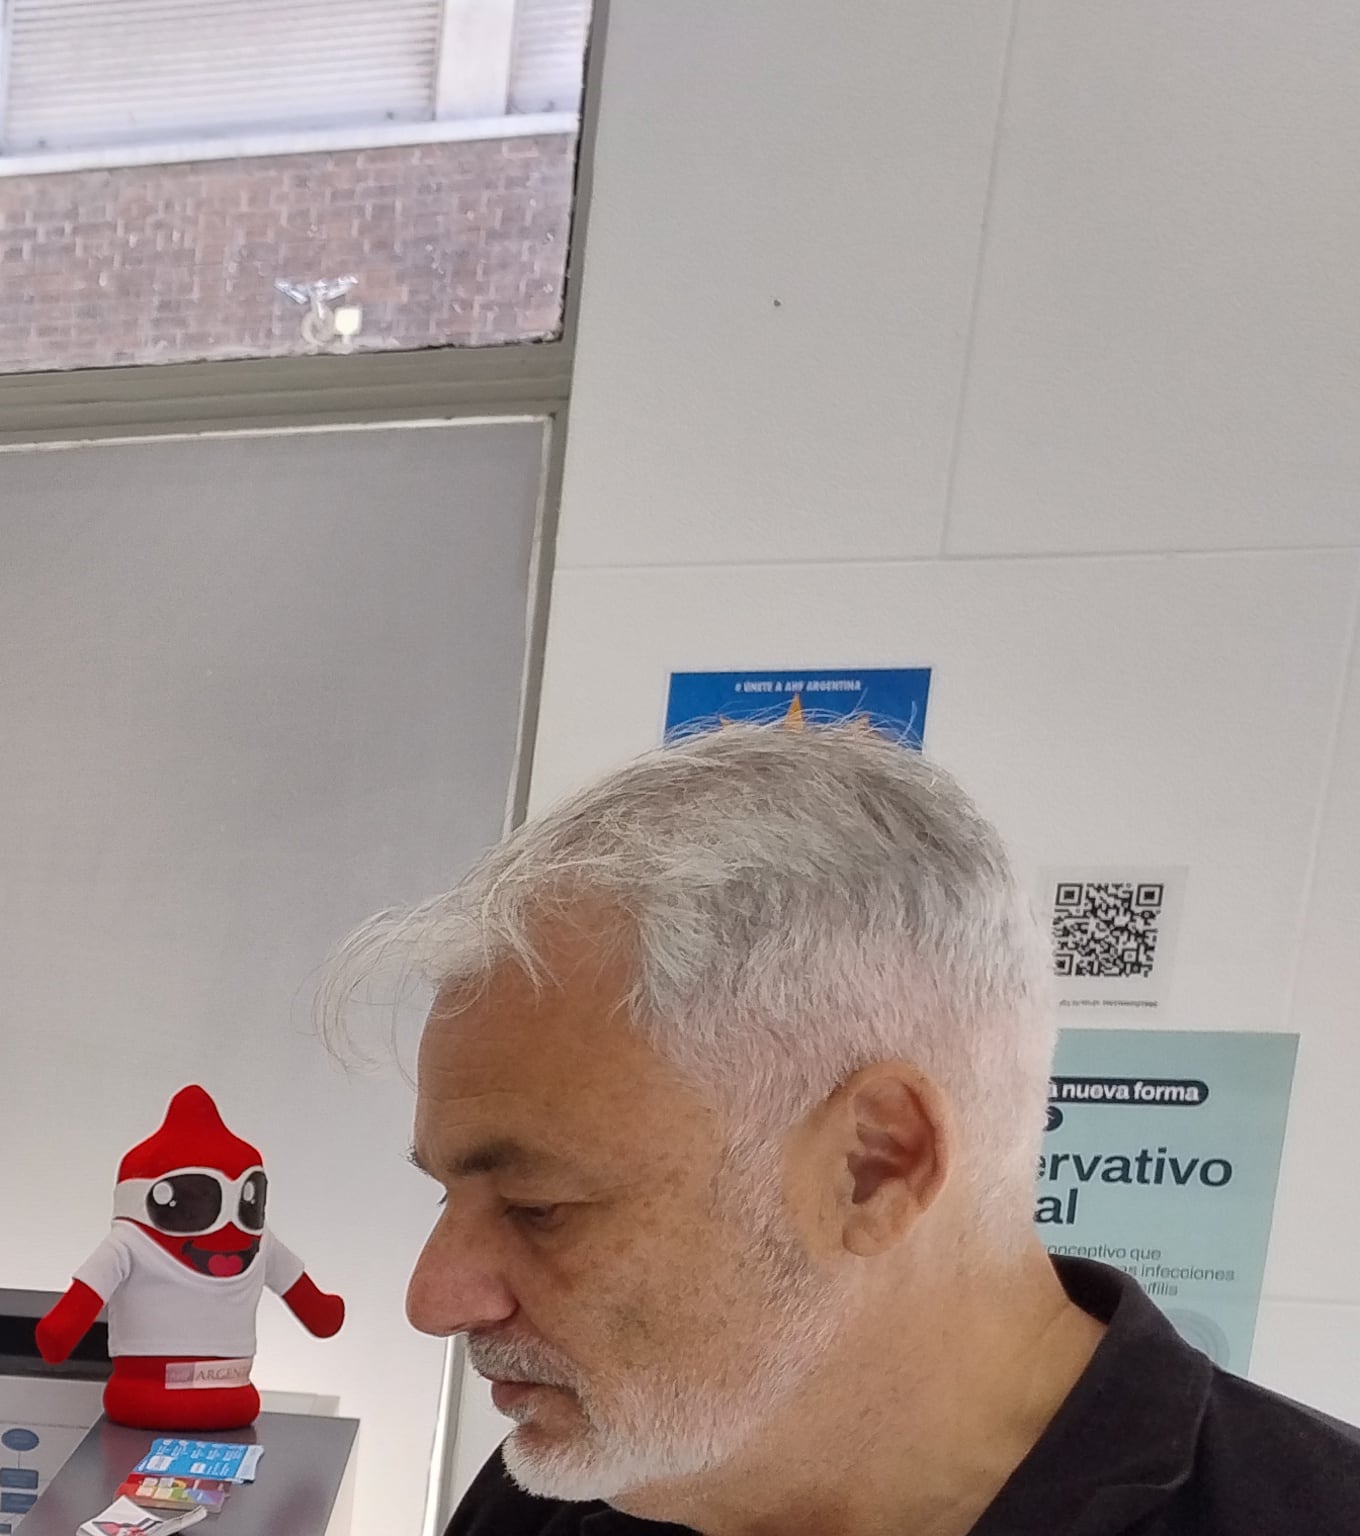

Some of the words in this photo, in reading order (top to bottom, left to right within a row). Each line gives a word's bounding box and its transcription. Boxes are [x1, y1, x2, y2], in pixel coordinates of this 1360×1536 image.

[1134, 1081, 1200, 1101] forma
[1130, 1249, 1162, 1261] que
[1141, 1265, 1235, 1281] infecciones
